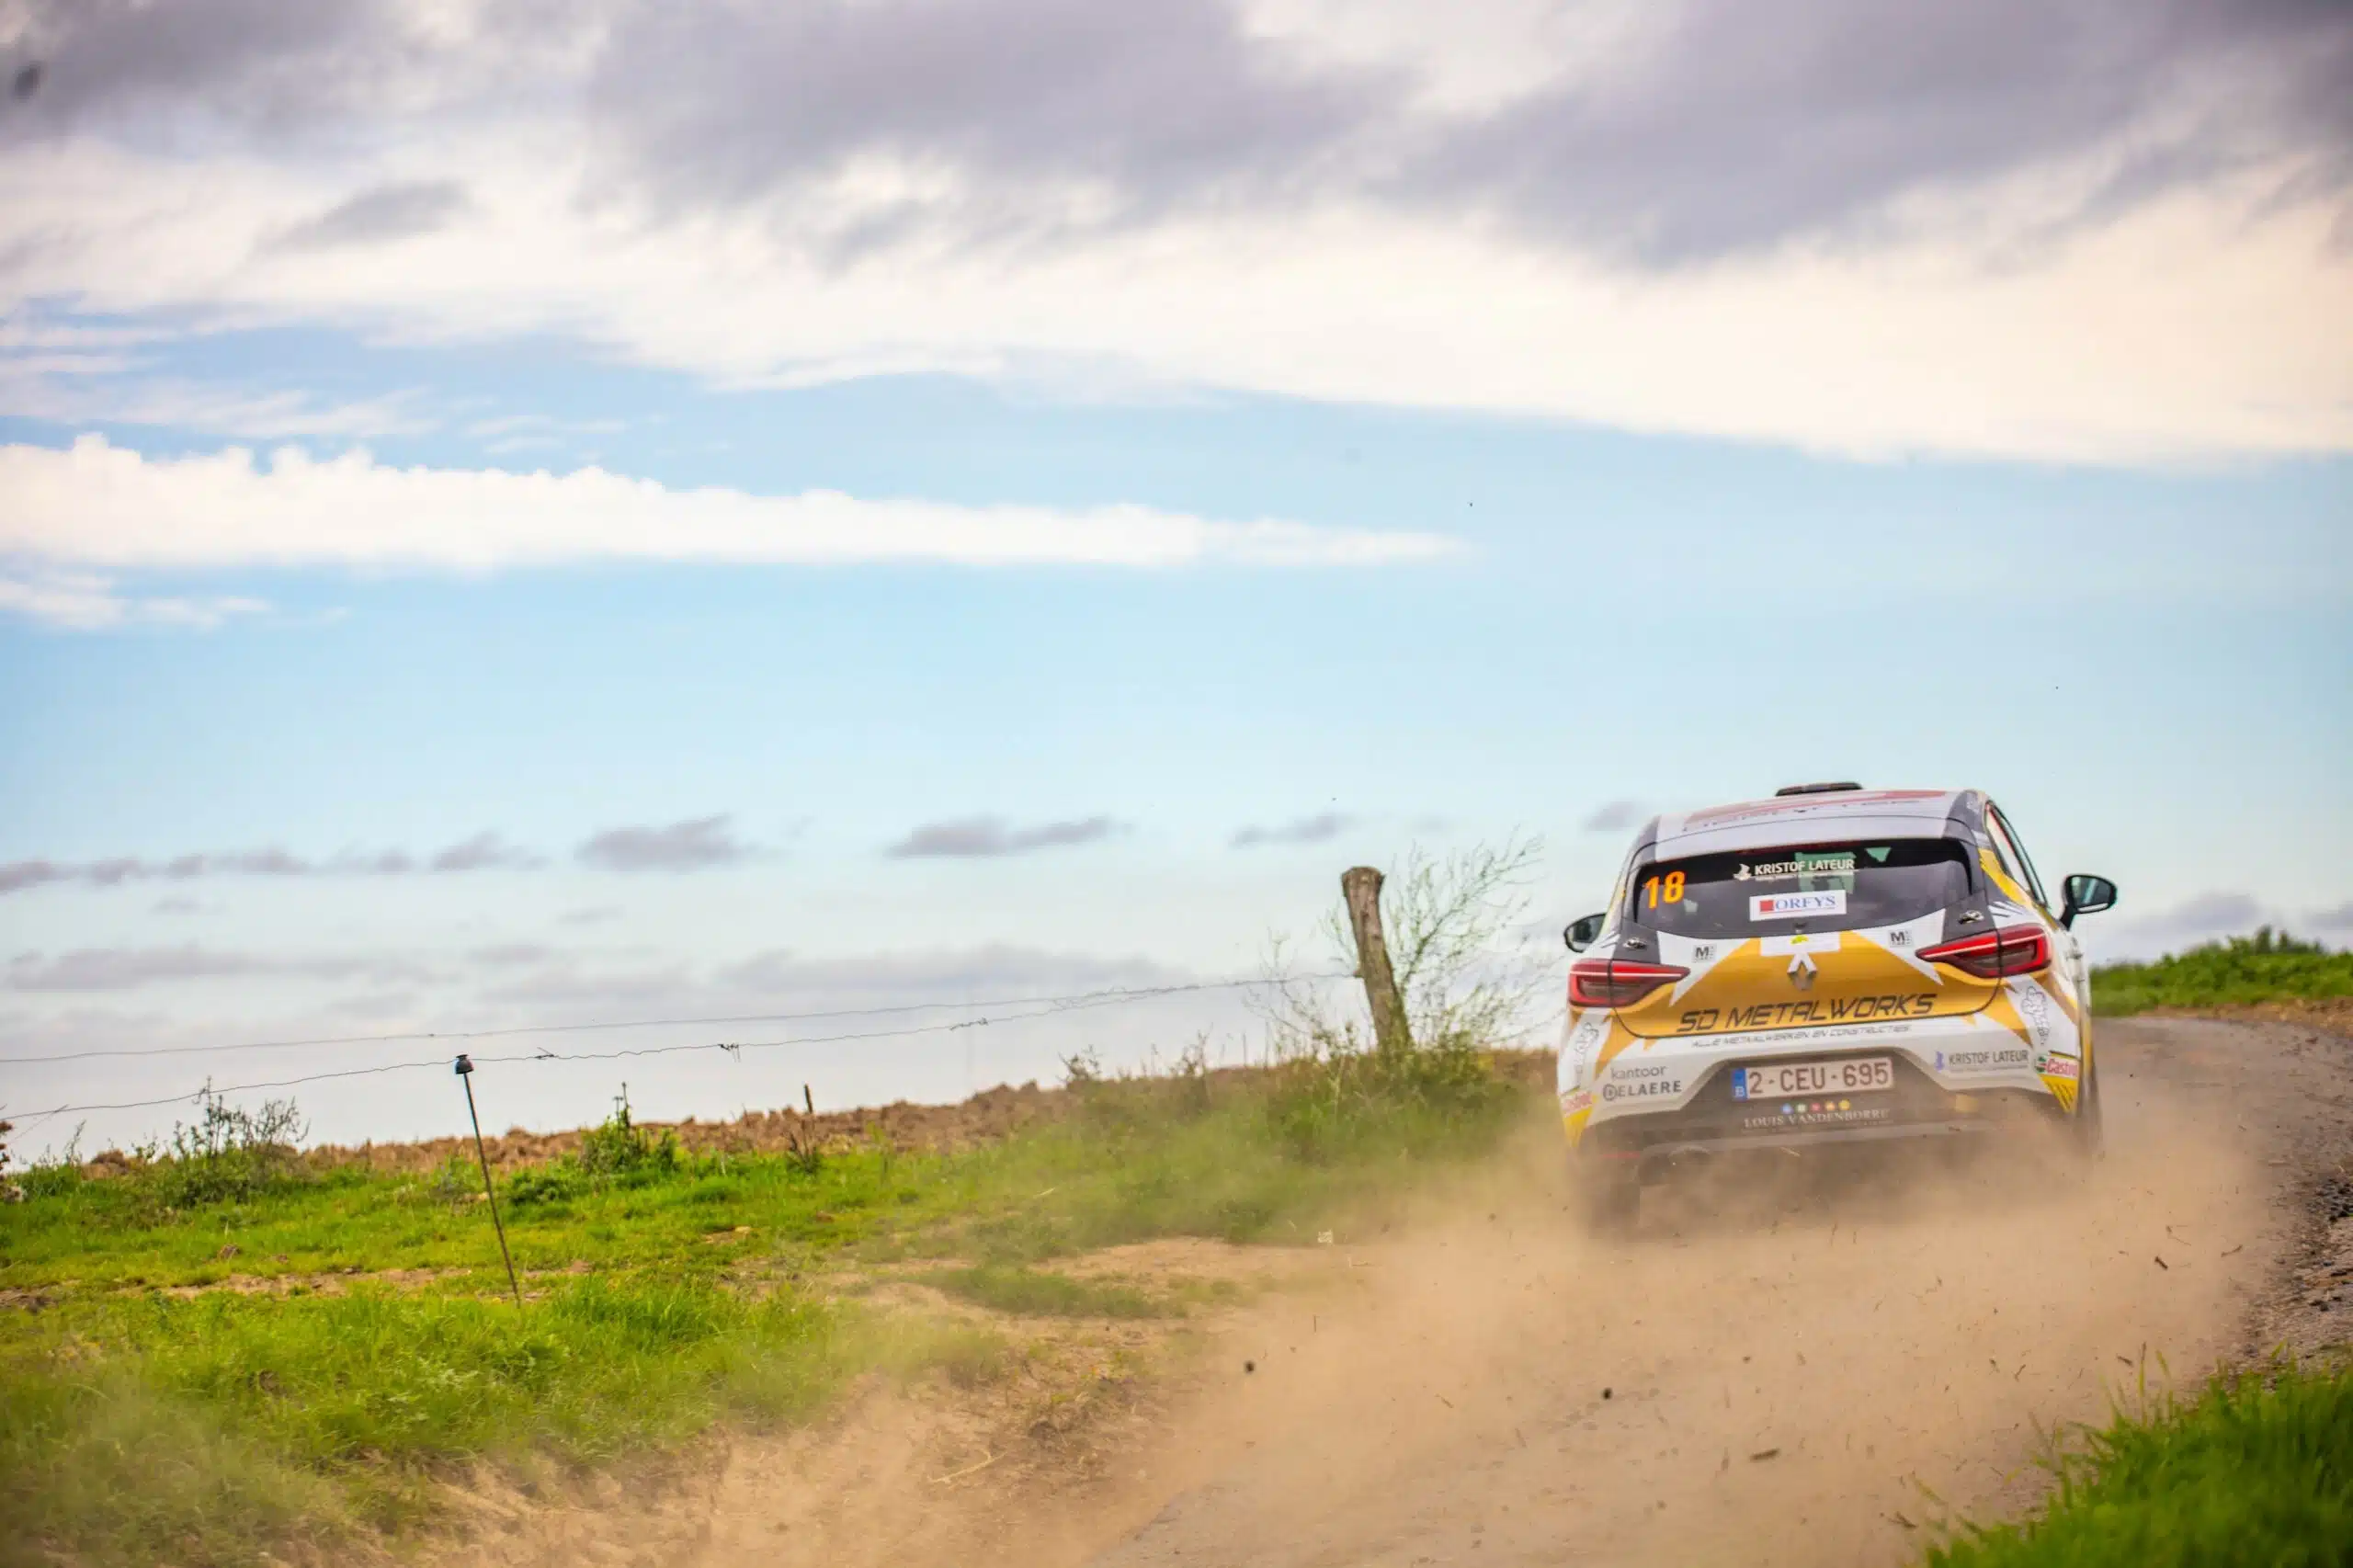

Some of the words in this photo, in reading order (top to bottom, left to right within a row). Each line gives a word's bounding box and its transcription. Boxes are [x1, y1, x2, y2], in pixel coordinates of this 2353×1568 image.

[1755, 861, 1805, 875] KRISTOF
[1809, 858, 1856, 871] LATEUR
[1643, 871, 1686, 910] 18
[1775, 896, 1836, 910] ORFYS
[1677, 1008, 1719, 1032] SD
[1724, 994, 1938, 1029] METALWORKS
[1949, 1051, 1990, 1065] KRISTOF
[1993, 1050, 2029, 1062] LATEUR
[1610, 1066, 1666, 1079] kantoor
[1744, 1115, 1784, 1128] LOUIS
